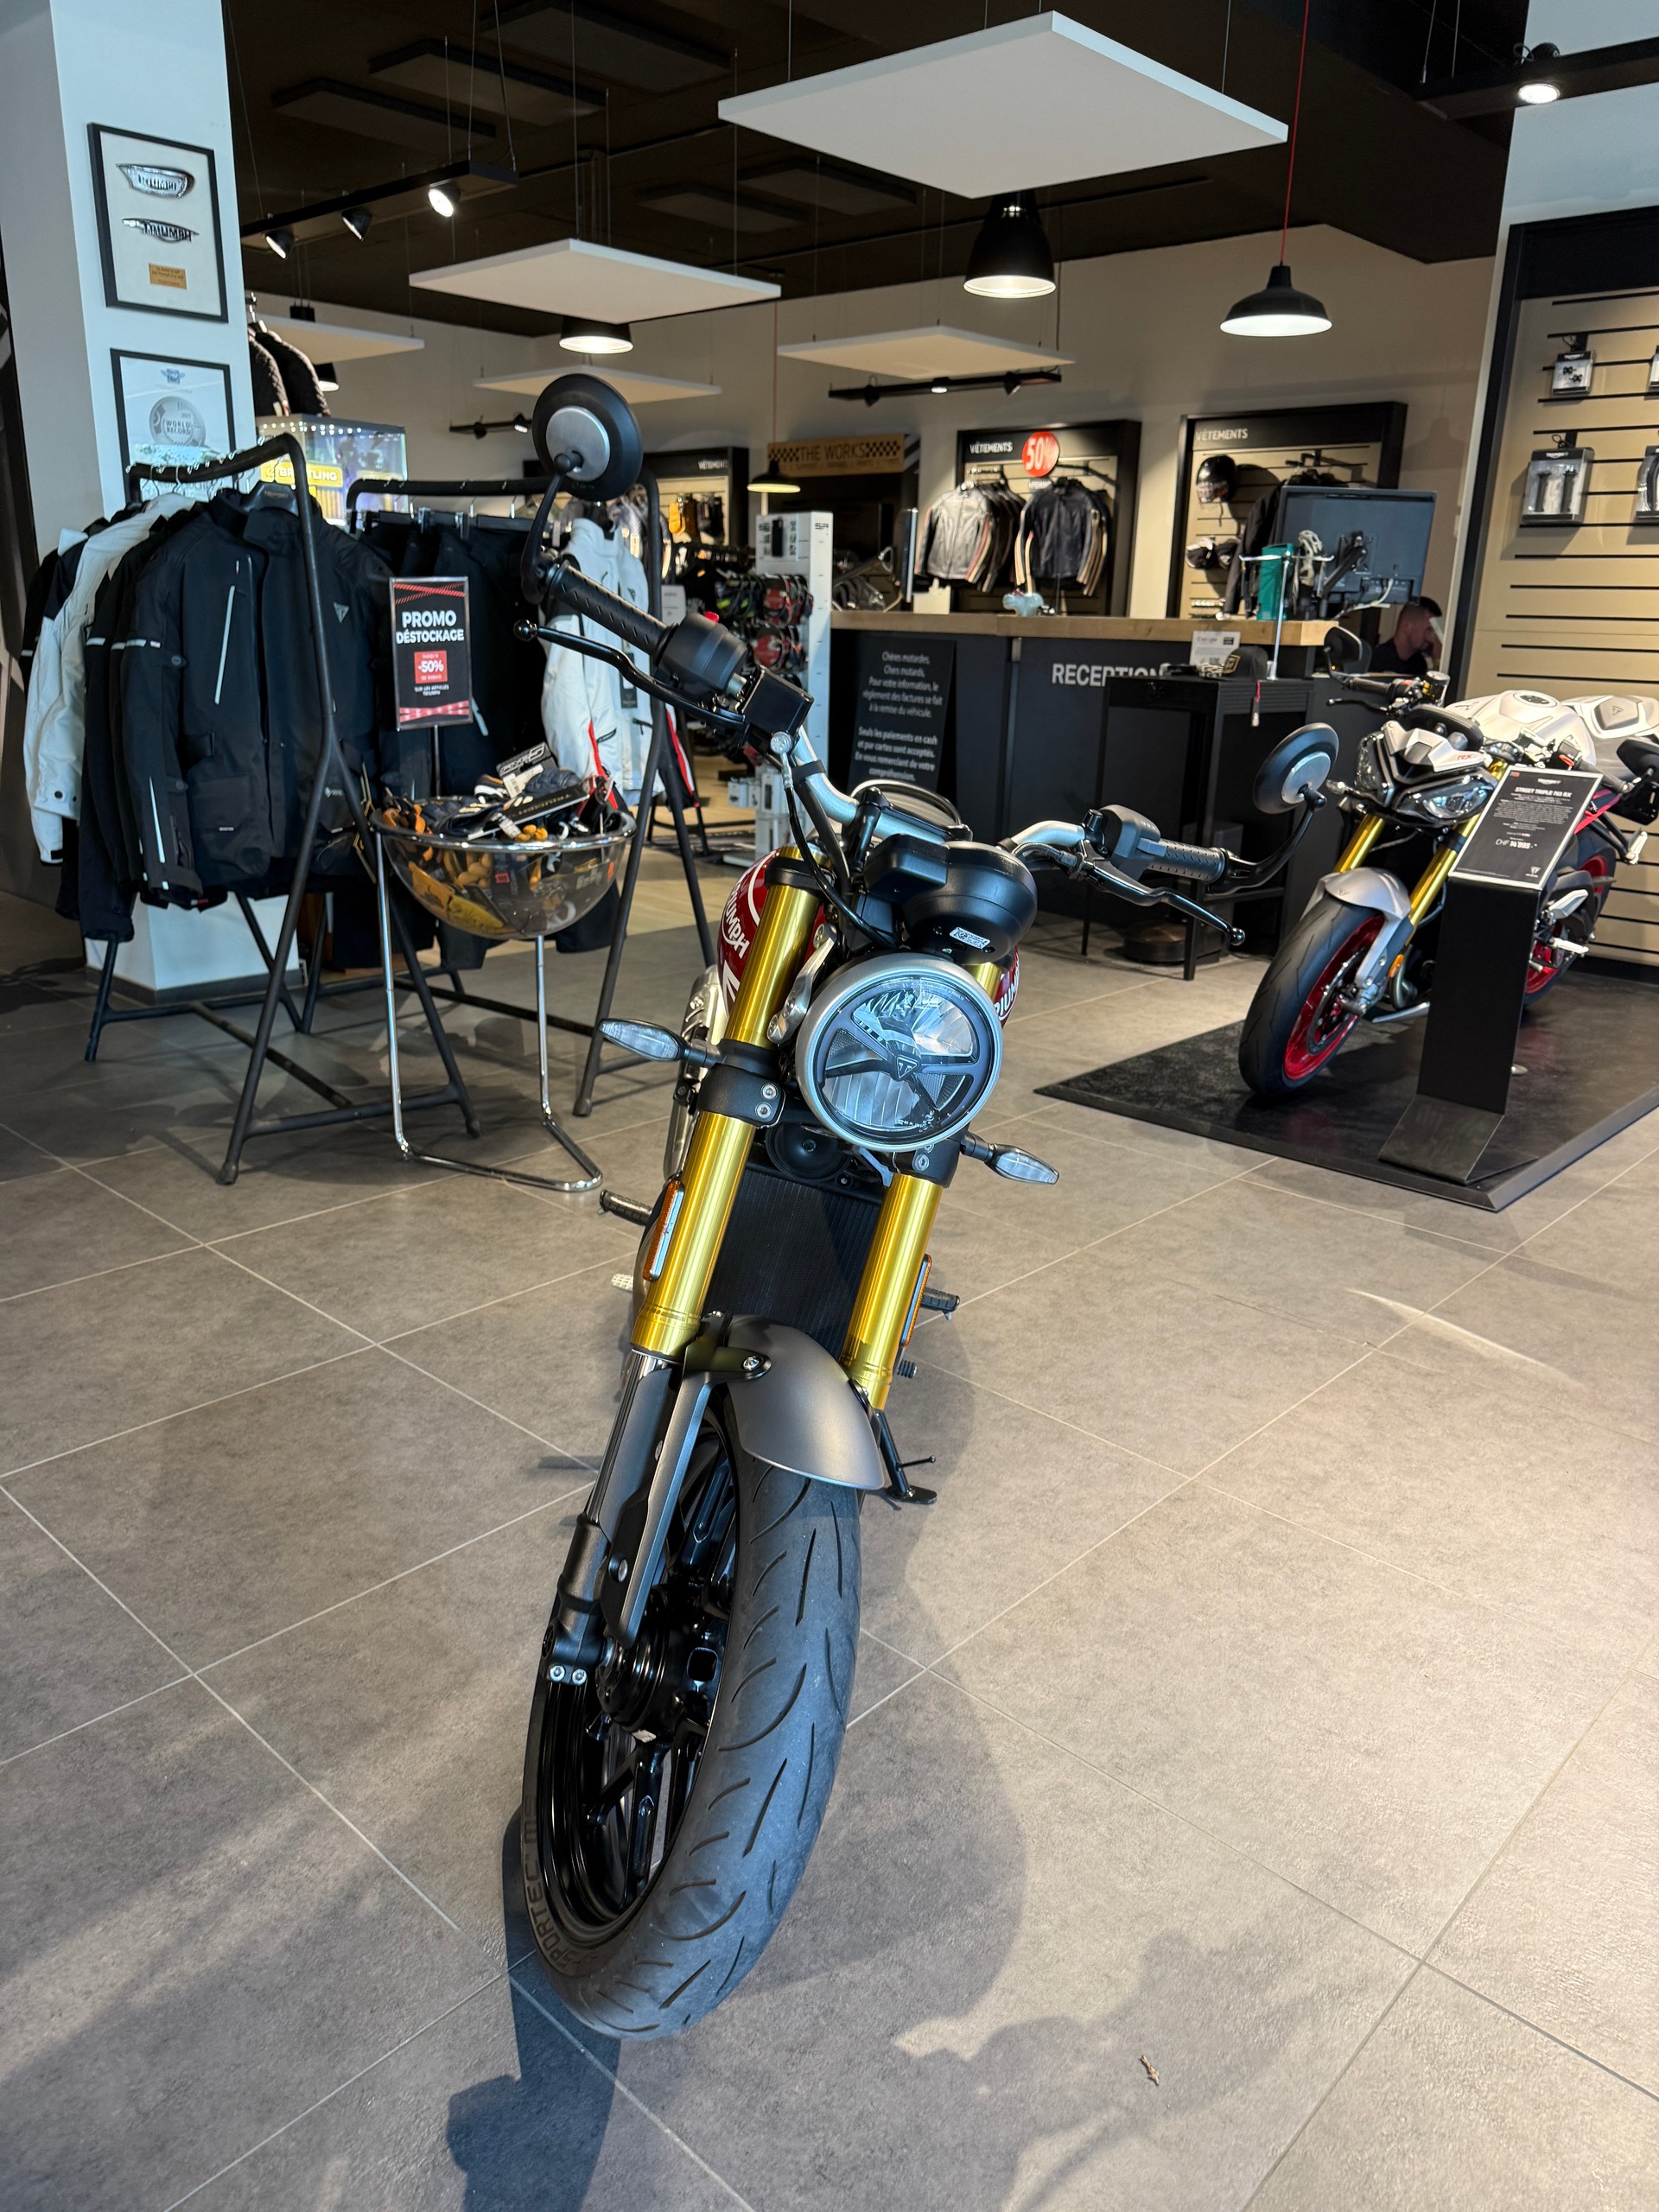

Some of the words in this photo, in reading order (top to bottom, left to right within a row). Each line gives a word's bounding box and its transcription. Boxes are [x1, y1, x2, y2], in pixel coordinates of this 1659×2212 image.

[1197, 428, 1248, 441] VÊTEMENTS
[800, 447, 820, 462] THE
[824, 443, 865, 461] WORKS
[969, 441, 1013, 454] VÊTEMENTS
[279, 467, 338, 482] BRTLING
[402, 610, 457, 628] PROMO
[396, 629, 465, 644] DÉSTOCKAGE
[417, 660, 444, 673] -50%
[868, 676, 881, 686] Pour
[882, 679, 897, 688] votre
[891, 692, 900, 702] des
[858, 727, 873, 737] Seuls
[882, 730, 913, 742] paiements
[923, 735, 938, 746] cash
[864, 741, 874, 751] par
[893, 745, 906, 753] sont
[855, 751, 862, 760] En
[863, 753, 876, 763] vous
[909, 759, 918, 769] de
[918, 762, 936, 772] votre
[722, 880, 750, 959] RIUMPH
